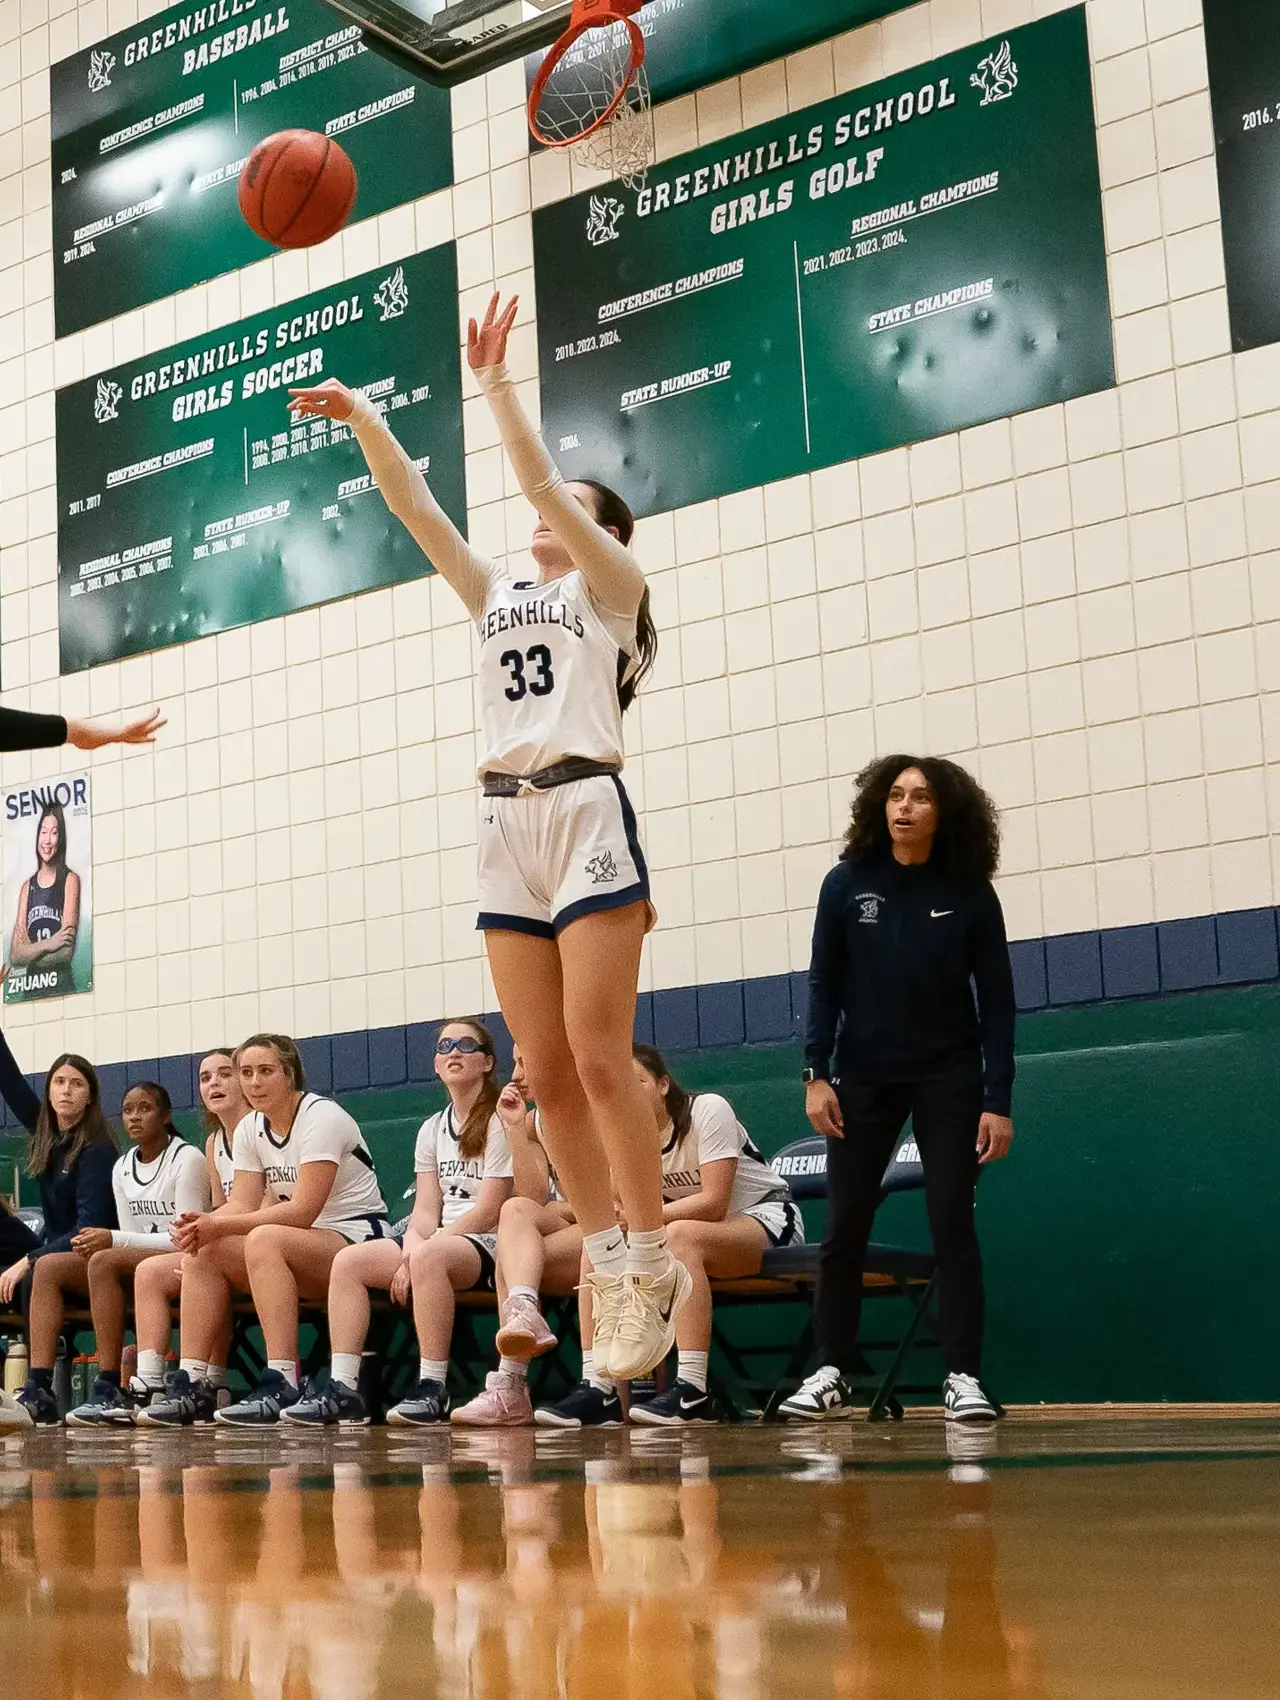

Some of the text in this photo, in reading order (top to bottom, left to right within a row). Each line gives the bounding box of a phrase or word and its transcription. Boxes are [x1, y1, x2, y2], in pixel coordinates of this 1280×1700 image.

[182, 6, 290, 76] BASEBALL
[279, 39, 324, 69] DISTRICT
[99, 93, 205, 151] CONFERENCE CHAMPIONS
[325, 85, 416, 135] STATE CHAMPIONS
[636, 77, 956, 218] GREENHILLS SCHOOL
[73, 191, 165, 242] REGIONAL CHAMPIO
[709, 146, 885, 235] GIRLS GOLF
[851, 170, 999, 234] REGIONAL CHAMPIONS
[598, 257, 745, 320] CONFERENCE CHAMPIONS
[869, 277, 994, 330] STATE CHAMPIONS
[131, 295, 364, 401] GREENHILLS SCHOOL
[171, 379, 234, 423] GIRLS
[241, 347, 324, 400] SOCCER
[620, 360, 732, 407] STATE RUNNER-UP
[106, 437, 215, 485] CONFERENCE CHAMPIONS
[337, 474, 370, 496] STATE
[122, 536, 173, 563] CHAMPIONS
[204, 516, 234, 538] STATE
[499, 643, 555, 702] 33
[4, 778, 87, 821] SENIOR
[8, 971, 58, 994] ZHUANG
